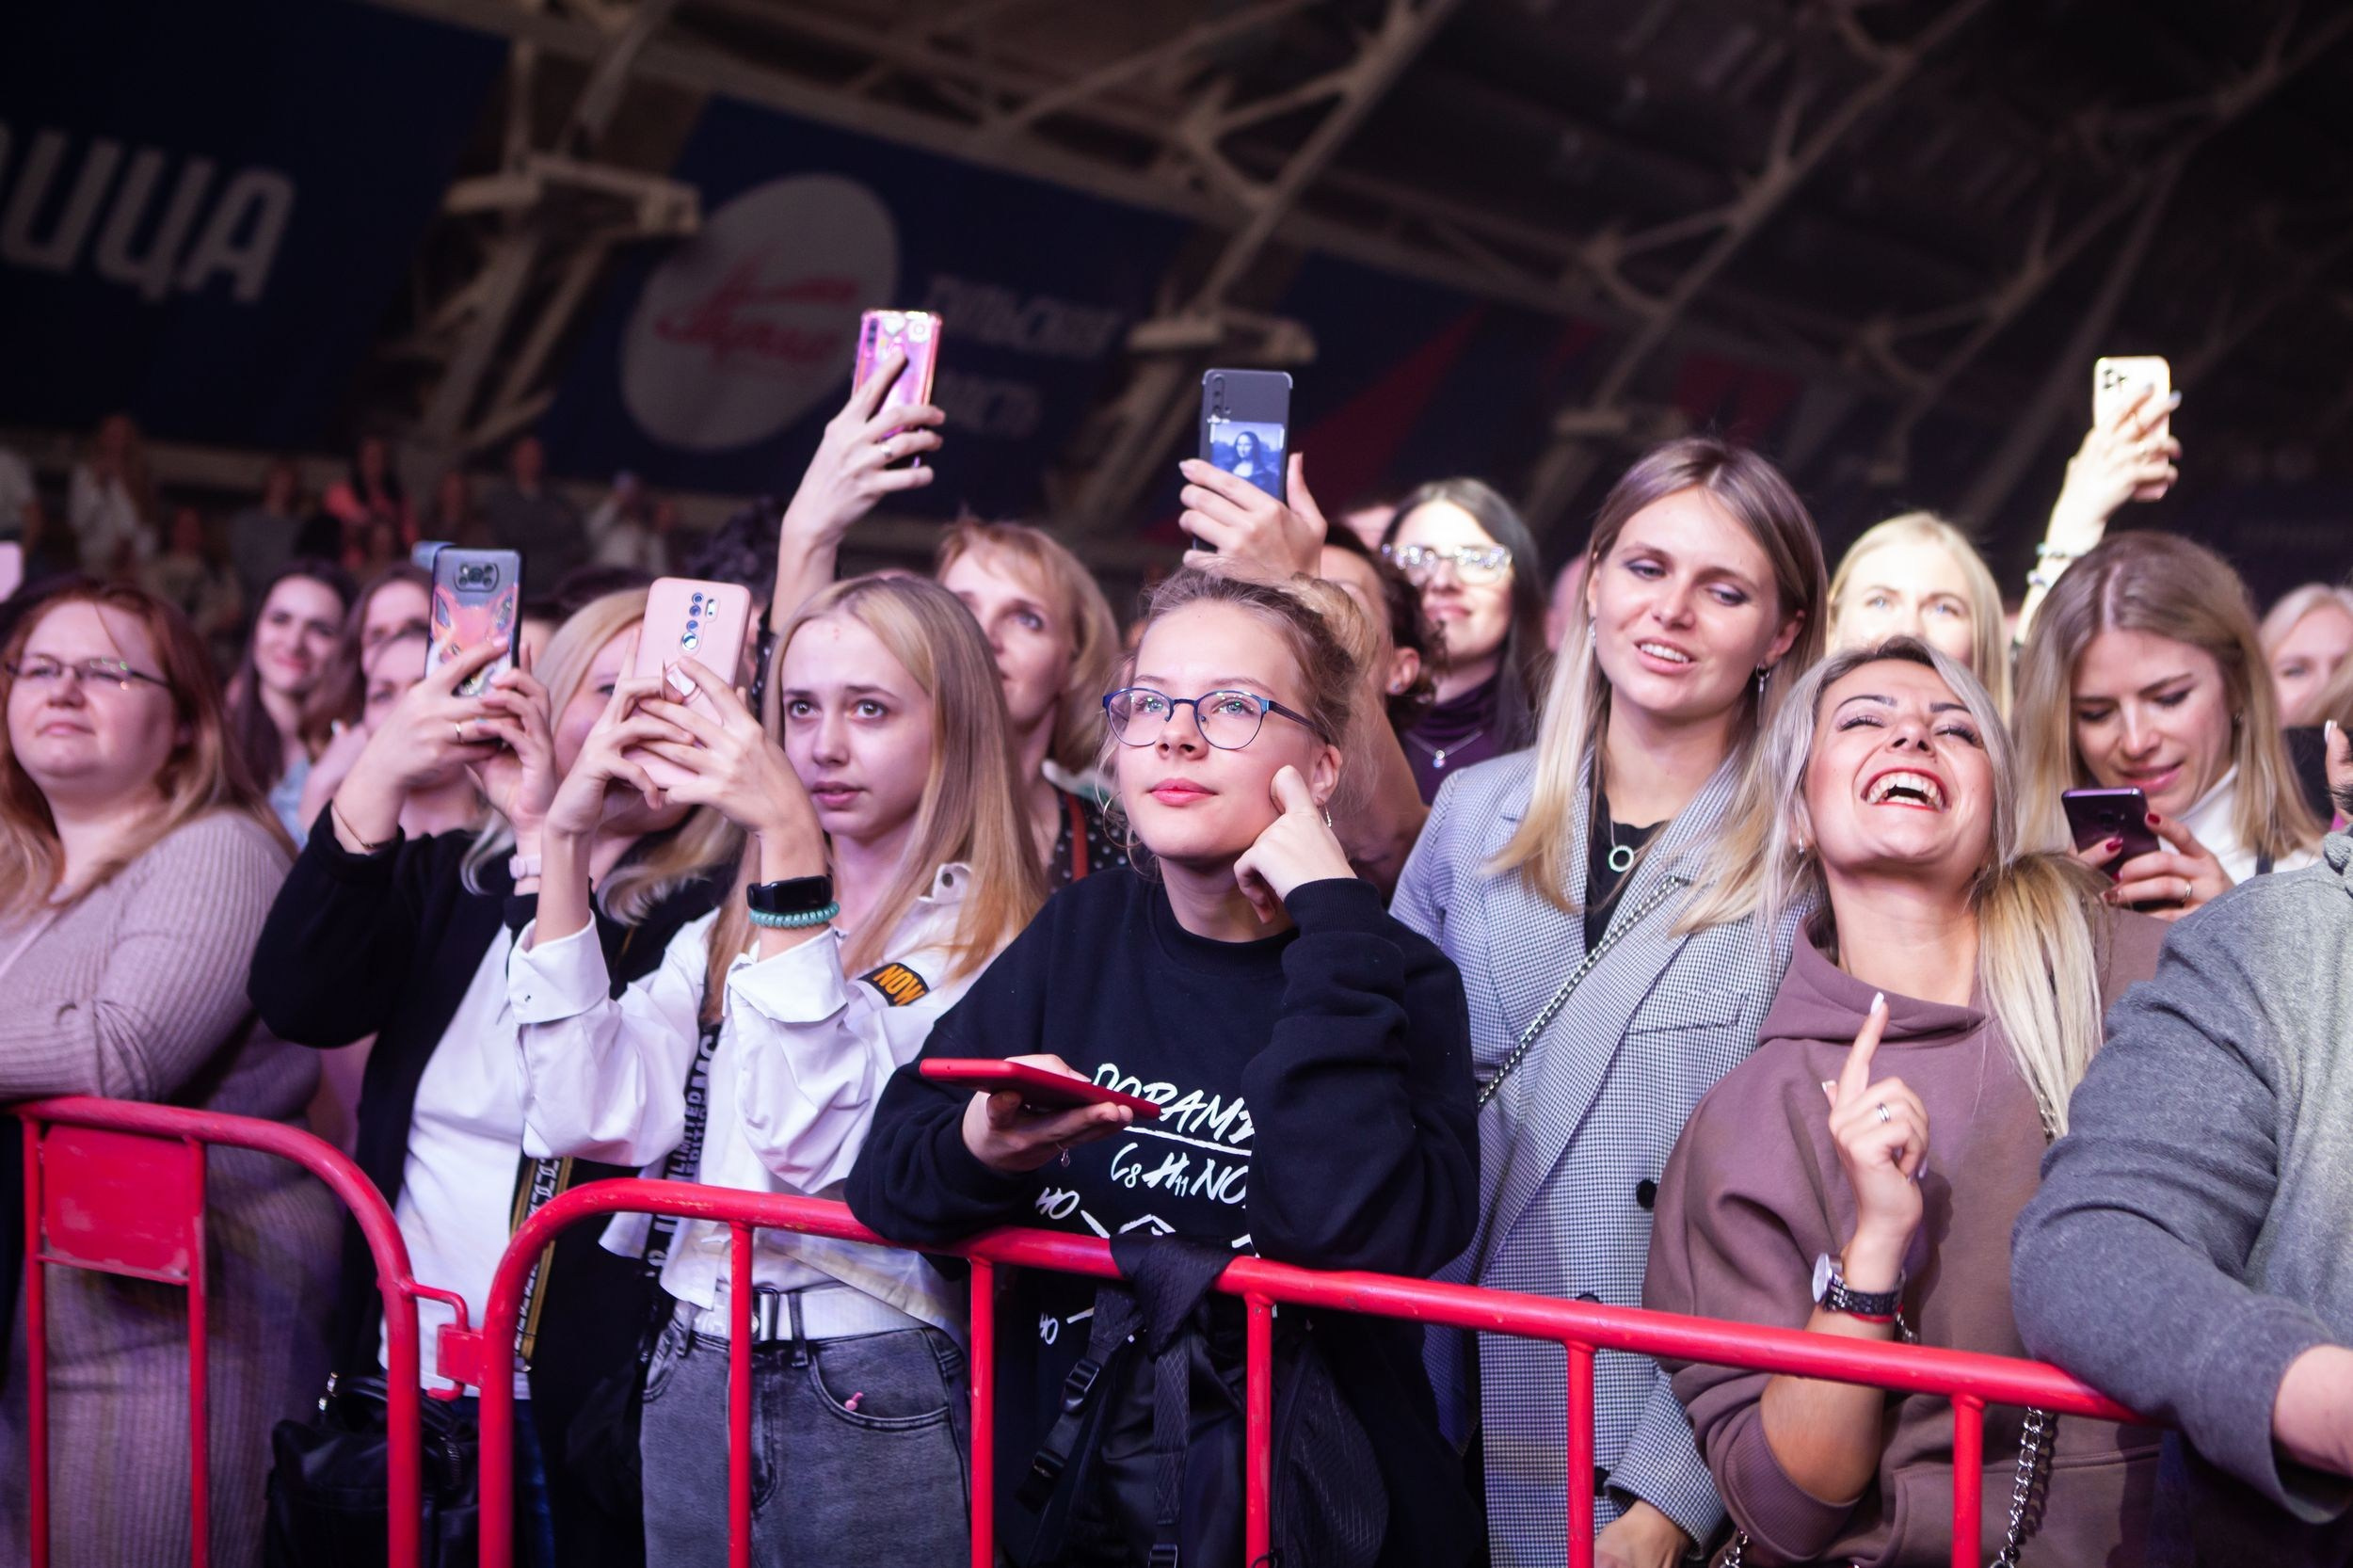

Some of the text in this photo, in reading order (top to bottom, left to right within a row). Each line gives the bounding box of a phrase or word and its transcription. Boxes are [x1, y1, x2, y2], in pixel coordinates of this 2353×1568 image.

[0, 122, 295, 303] ИЦА
[873, 965, 926, 1006] NOW
[1035, 1187, 1080, 1220] HO
